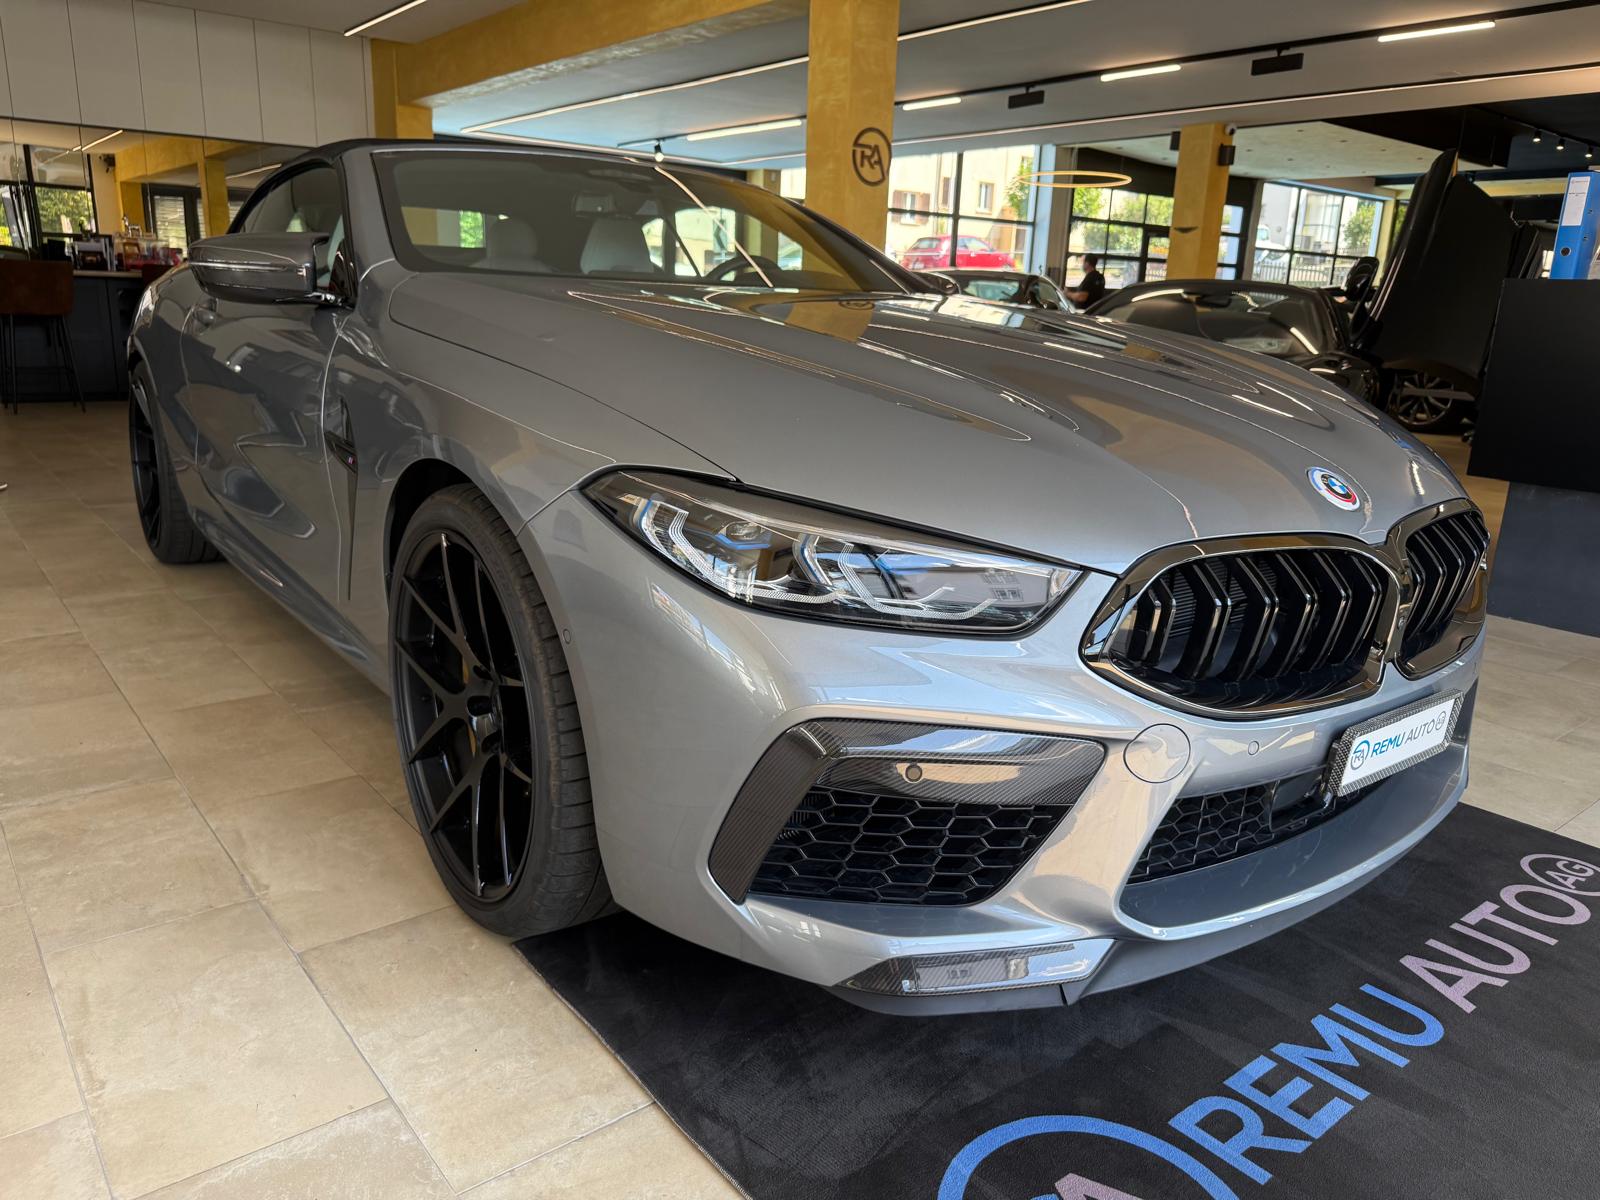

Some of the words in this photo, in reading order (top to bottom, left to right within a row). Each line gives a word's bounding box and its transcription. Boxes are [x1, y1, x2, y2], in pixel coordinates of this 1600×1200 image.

[1370, 731, 1405, 757] REMU
[1404, 719, 1434, 744] AUTO
[1168, 983, 1445, 1185] REMU
[1399, 884, 1591, 1014] AUTO
[1545, 860, 1595, 890] AG
